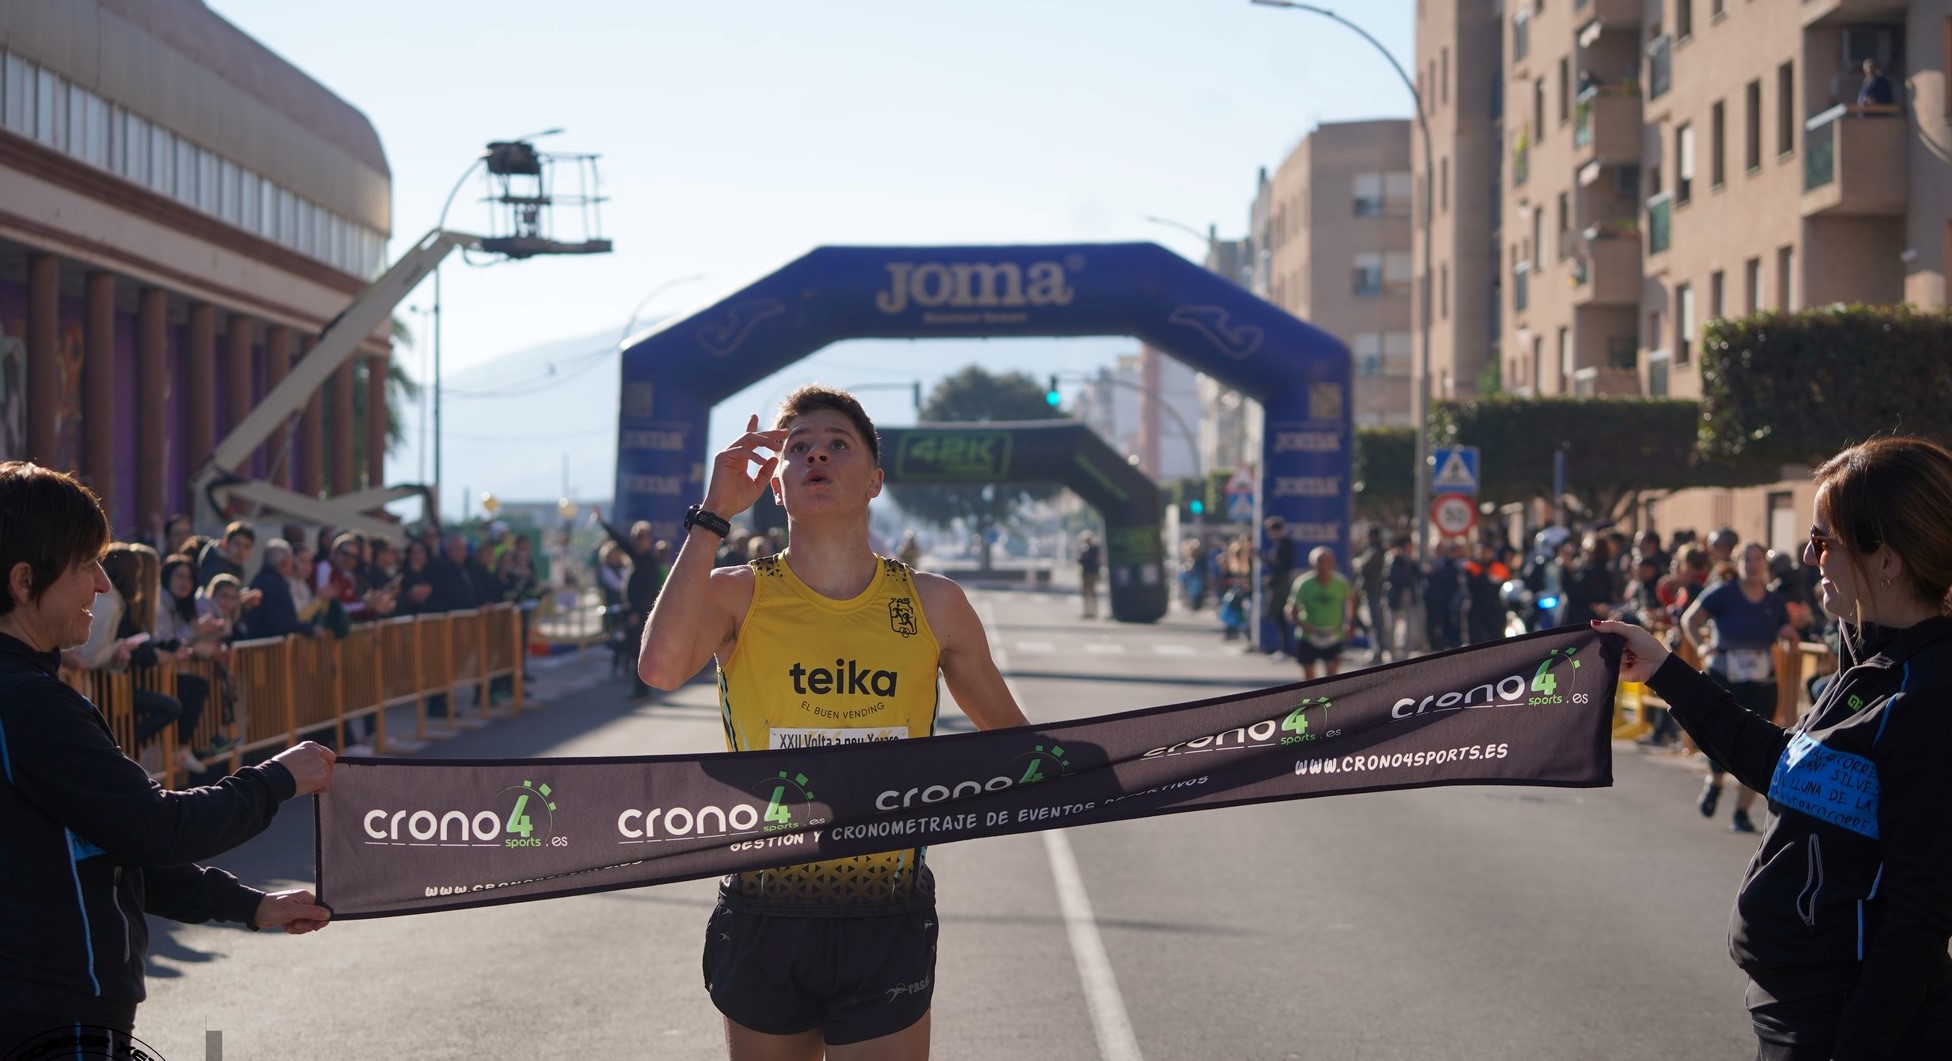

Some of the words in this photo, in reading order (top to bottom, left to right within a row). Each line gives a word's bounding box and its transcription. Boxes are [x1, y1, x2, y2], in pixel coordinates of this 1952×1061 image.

[789, 658, 898, 697] teika
[801, 700, 811, 712] EL
[814, 706, 840, 719] BUEN
[842, 702, 885, 719] VENDING
[779, 734, 802, 748] XXII
[1294, 743, 1509, 775] WWW.CRONO4SPORTS.ES
[1829, 789, 1847, 804] DE
[1855, 797, 1871, 812] LA
[813, 830, 824, 842] Y
[831, 813, 977, 840] CRONOMETRAJE
[986, 811, 1009, 826] DE
